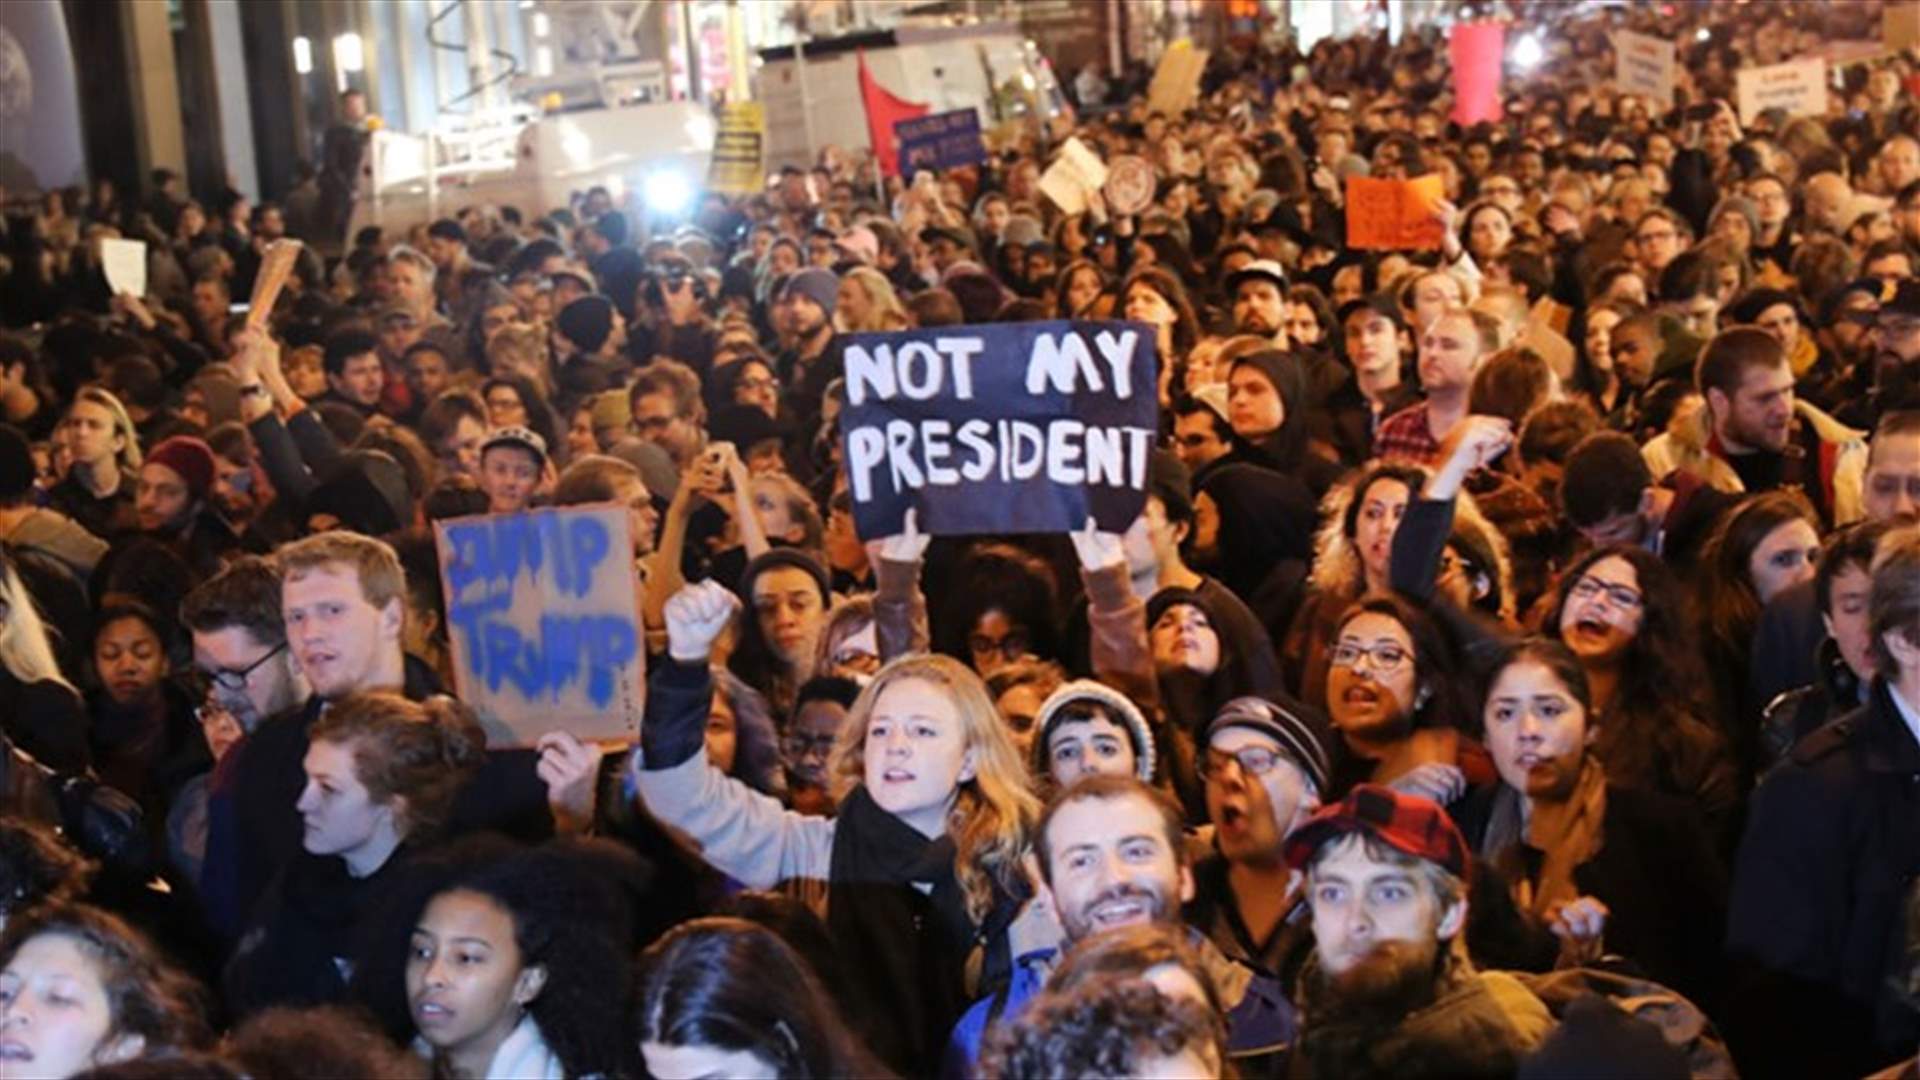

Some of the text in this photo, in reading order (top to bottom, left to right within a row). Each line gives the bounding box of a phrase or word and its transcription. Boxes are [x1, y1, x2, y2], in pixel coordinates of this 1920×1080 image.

[844, 330, 1138, 406] NOT MY
[848, 418, 1156, 502] PRESIDENT
[450, 592, 637, 709] TRUMP
